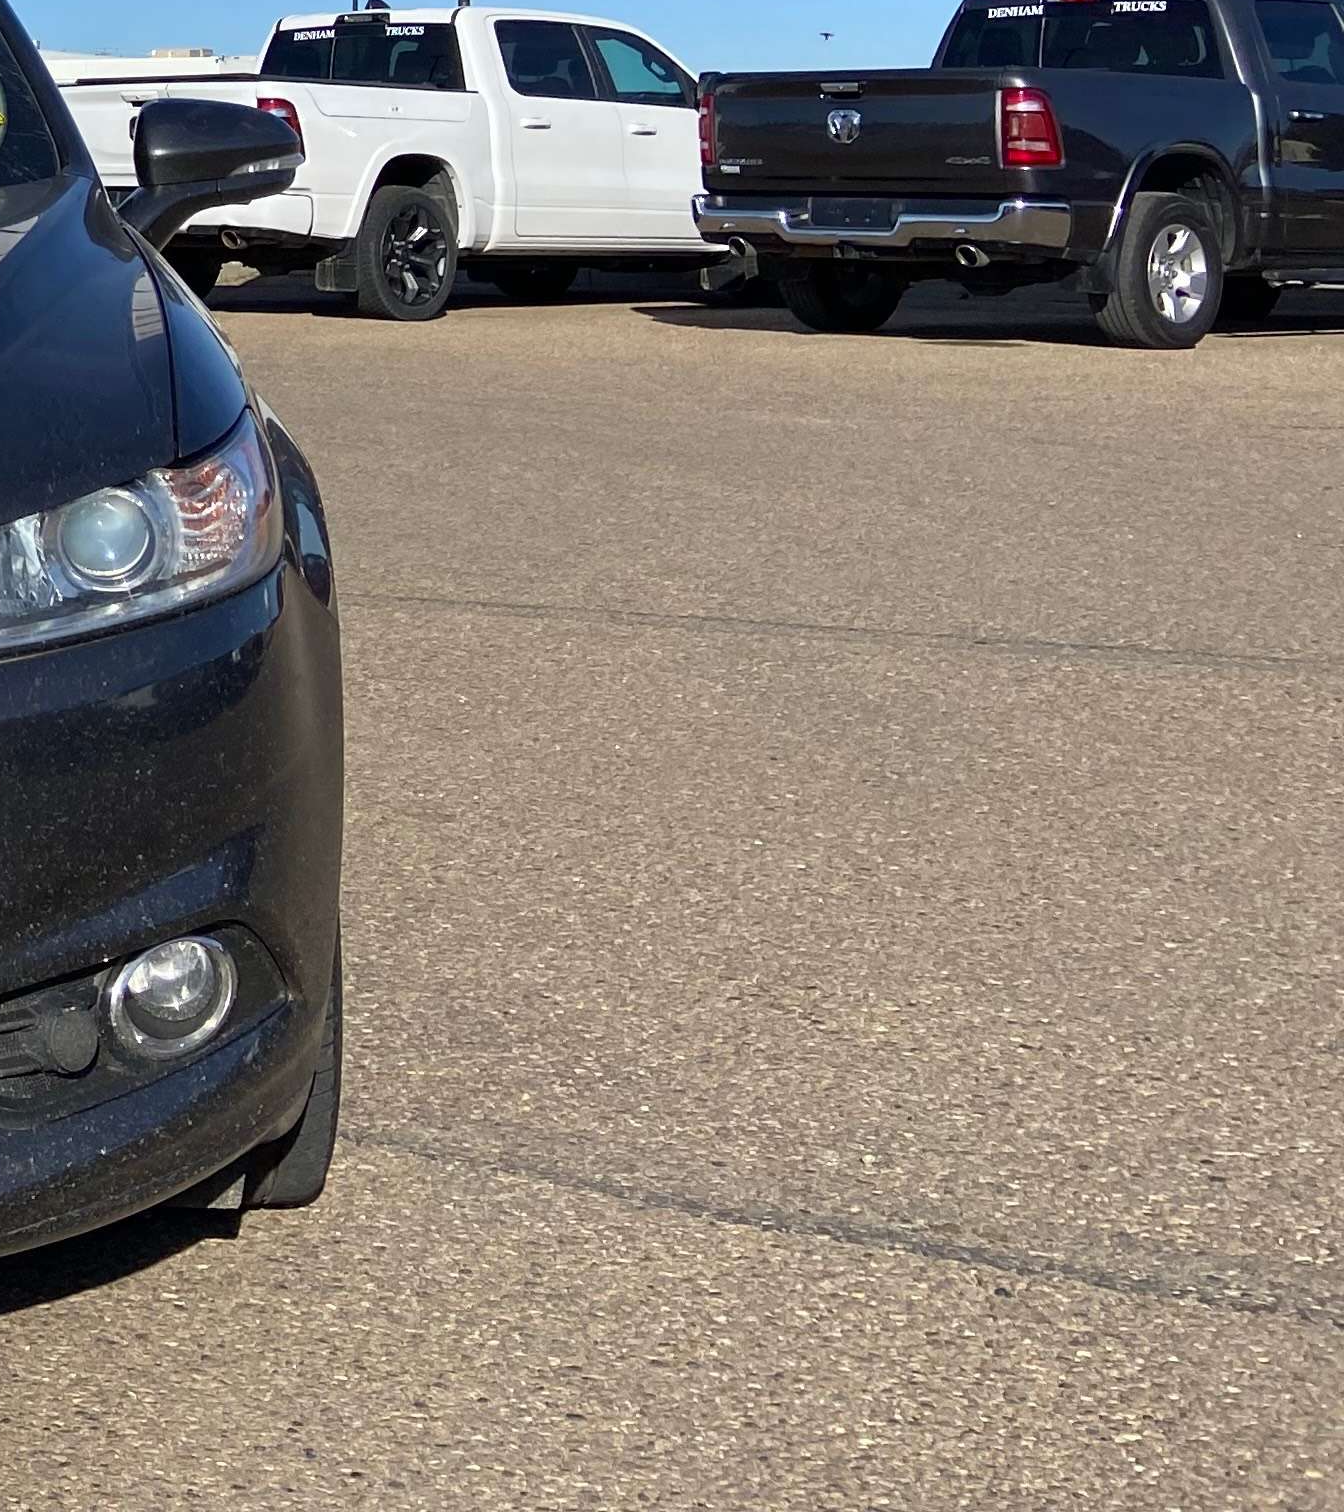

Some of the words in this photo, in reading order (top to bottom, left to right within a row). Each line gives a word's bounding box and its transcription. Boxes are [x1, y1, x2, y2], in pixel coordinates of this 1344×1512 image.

[987, 4, 1045, 19] DENHAM
[1113, 1, 1167, 12] TRUCKS
[293, 29, 336, 41] DENHAM
[385, 25, 425, 36] TRUCKS
